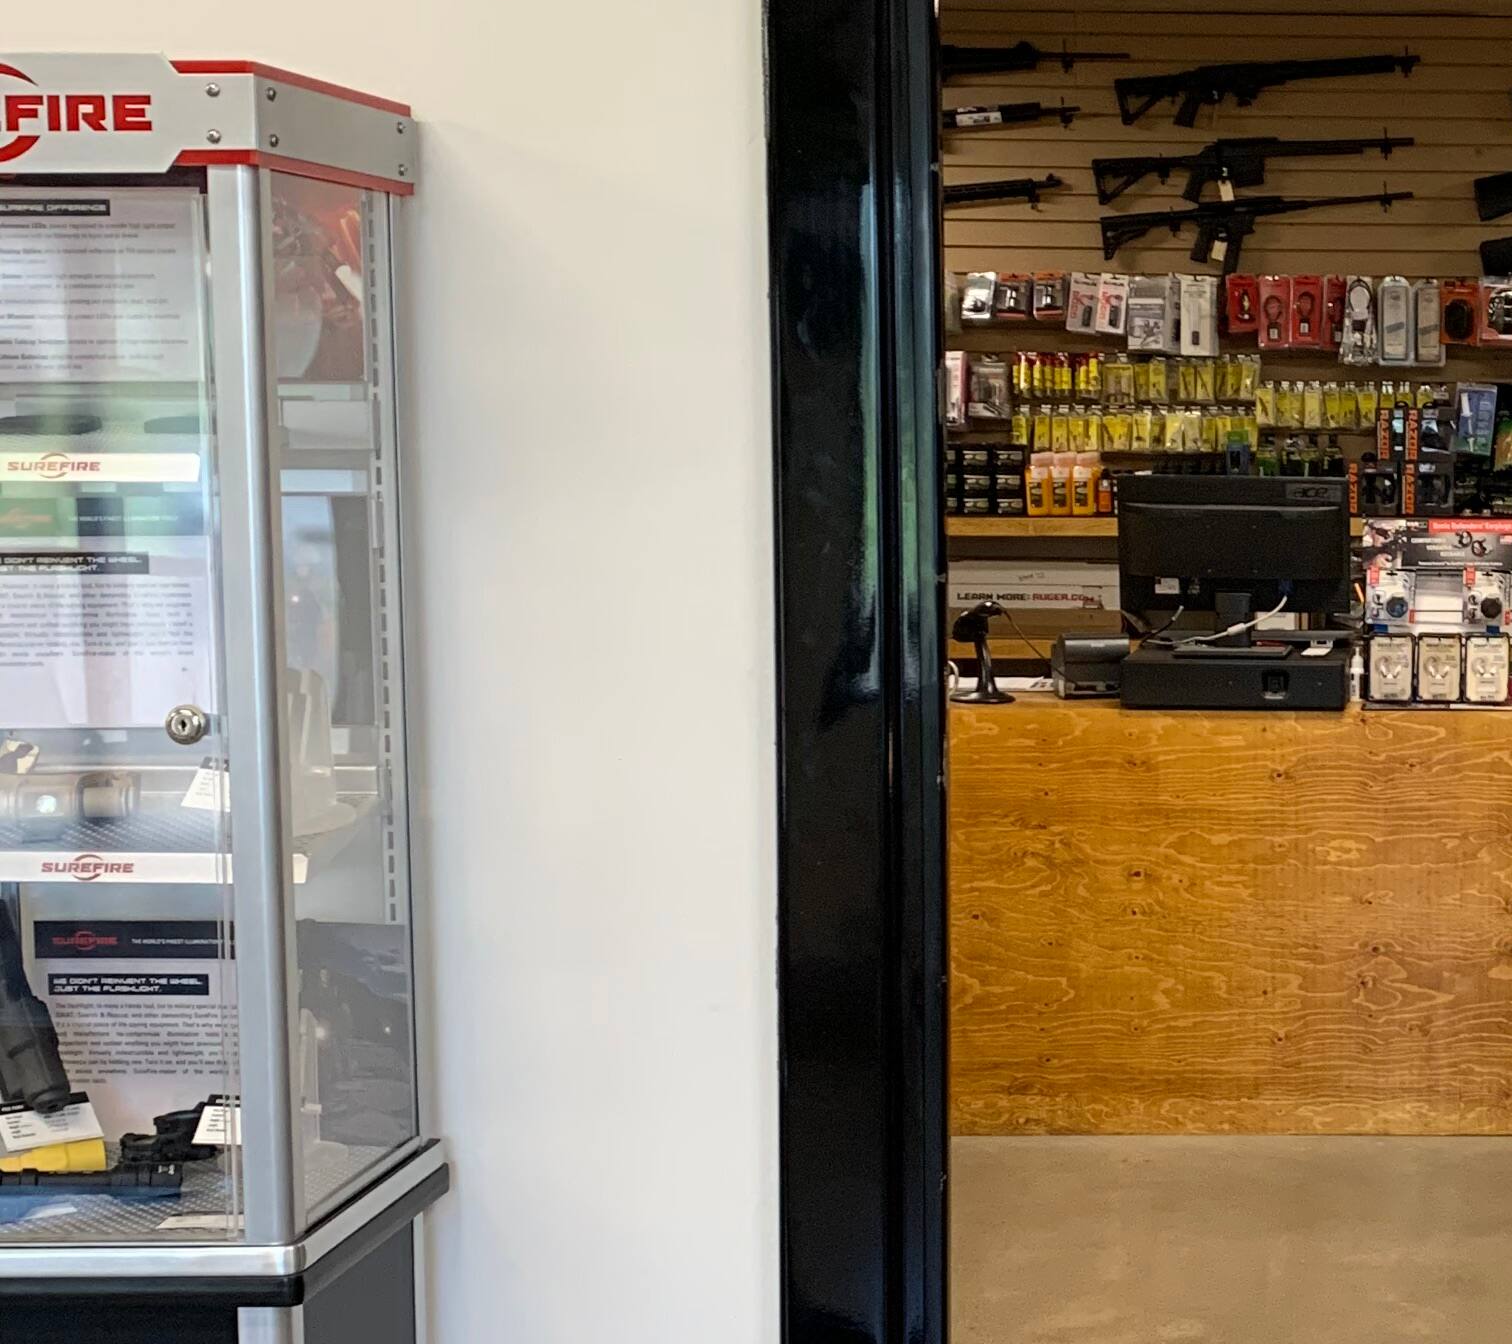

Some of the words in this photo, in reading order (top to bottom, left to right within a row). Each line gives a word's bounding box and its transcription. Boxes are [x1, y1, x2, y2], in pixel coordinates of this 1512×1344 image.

[0, 94, 153, 132] FIRE
[1379, 409, 1390, 459] RAZOR
[1408, 409, 1419, 461] RAZOR
[7, 461, 101, 472] SUREFIRE
[1405, 463, 1415, 514] RAZOR
[957, 592, 994, 601] LEARN
[996, 592, 1030, 601] MORE:
[41, 862, 135, 874] SUREFIRE
